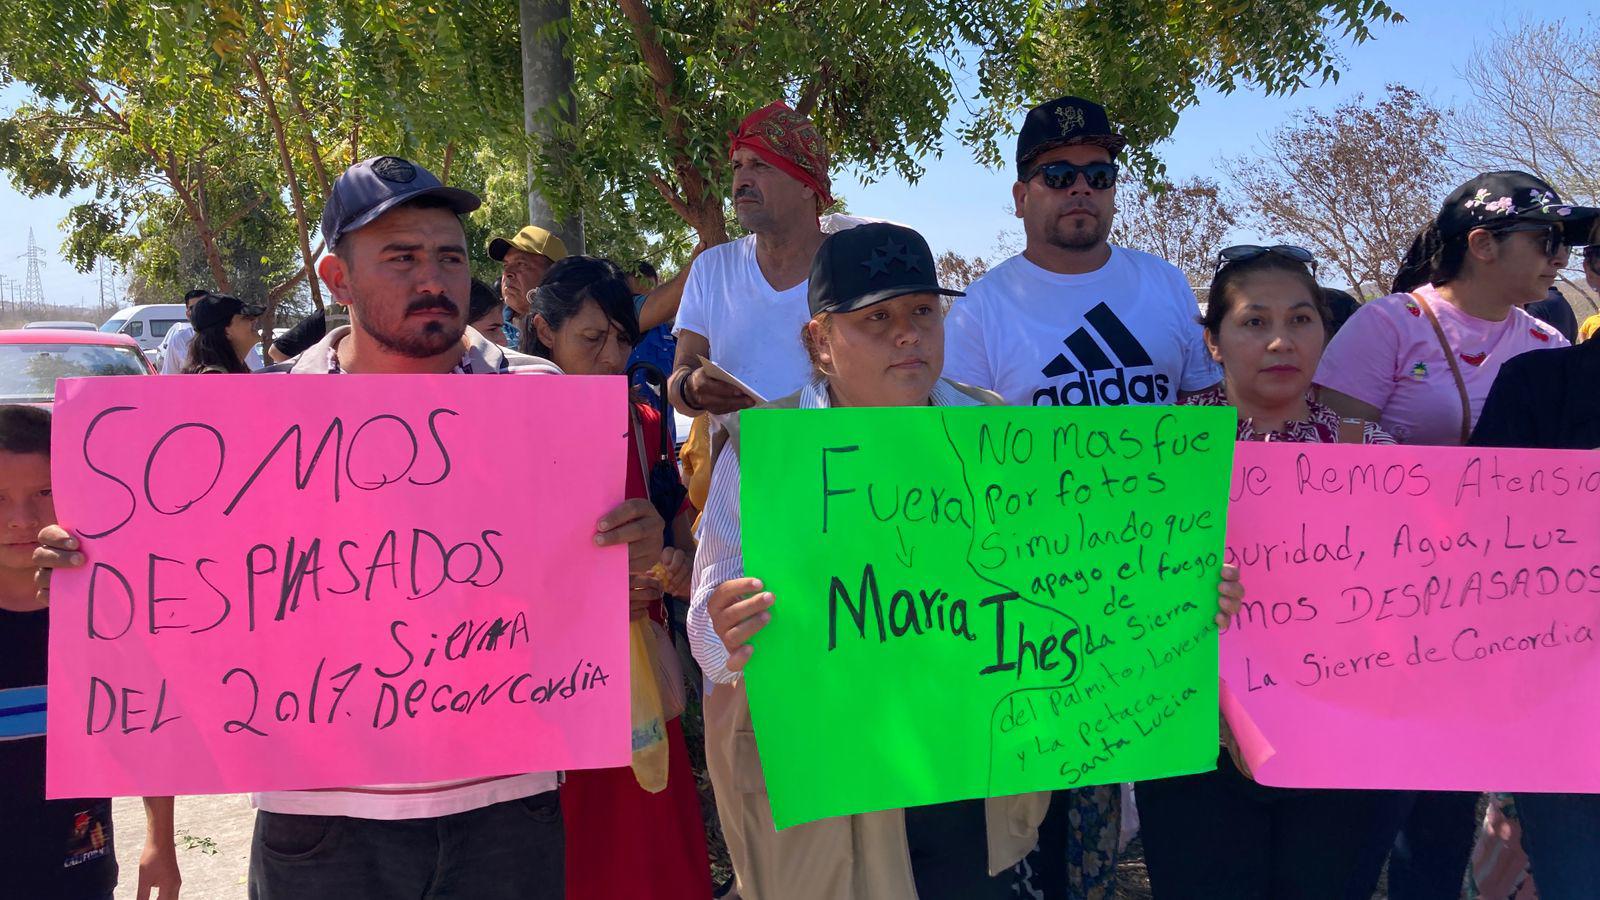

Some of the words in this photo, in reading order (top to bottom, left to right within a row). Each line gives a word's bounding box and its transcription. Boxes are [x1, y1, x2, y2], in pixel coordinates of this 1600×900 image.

[1032, 367, 1169, 407] adidas
[1154, 413, 1211, 465] fue
[75, 405, 460, 540] SOMOS
[821, 445, 972, 534] Fuera
[1117, 543, 1146, 580] el
[828, 563, 977, 651] Maria
[1246, 657, 1277, 693] La
[1406, 635, 1447, 666] de
[87, 675, 182, 736] DEL
[1000, 697, 1035, 734] del
[1059, 737, 1131, 785] Santa
[1136, 687, 1198, 737] Lucia
